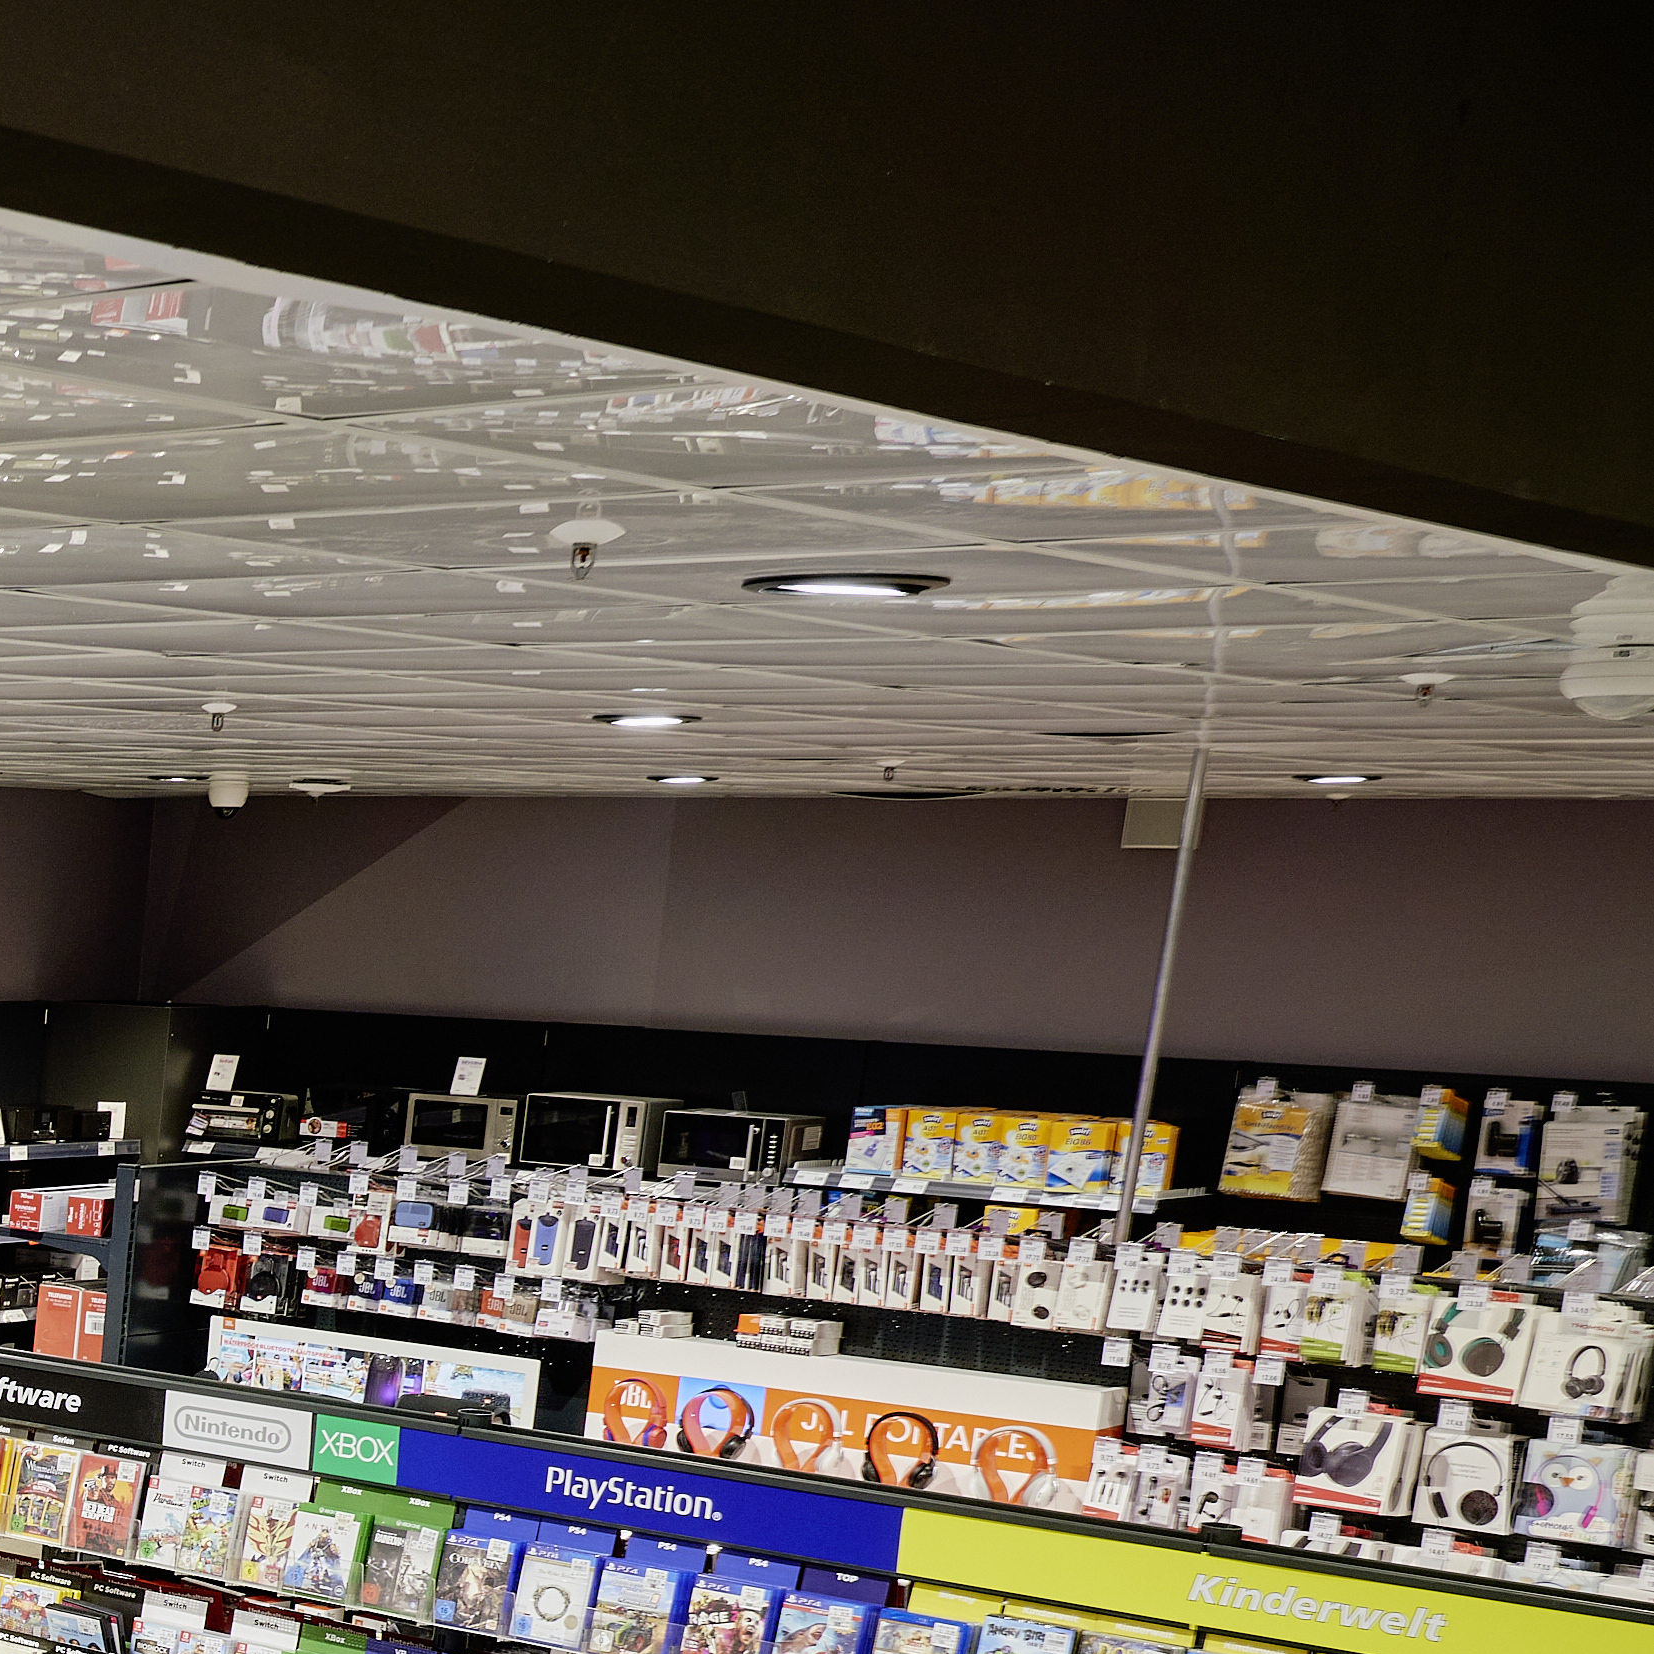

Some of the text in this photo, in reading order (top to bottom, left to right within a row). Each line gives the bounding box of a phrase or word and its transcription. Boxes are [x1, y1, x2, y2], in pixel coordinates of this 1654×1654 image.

[312, 1275, 329, 1290] JBL
[390, 1285, 407, 1299] JBL
[429, 1289, 446, 1304] JBL
[183, 1413, 282, 1447] Nintendo
[52, 1434, 76, 1446] Serien
[107, 1444, 151, 1459] PC Software
[318, 1430, 396, 1467] XBOX
[181, 1458, 206, 1469] Switch
[263, 1472, 289, 1484] Switch
[341, 1485, 364, 1497] XBox
[493, 1511, 512, 1523] PS4
[568, 1525, 588, 1536] PS4
[657, 1540, 678, 1552] PS4
[30, 1571, 73, 1587] PC Software
[835, 1572, 859, 1584] TOP
[1187, 1573, 1449, 1643] Kinderwelt
[253, 1618, 280, 1631] Switch
[324, 1631, 347, 1644] XBox
